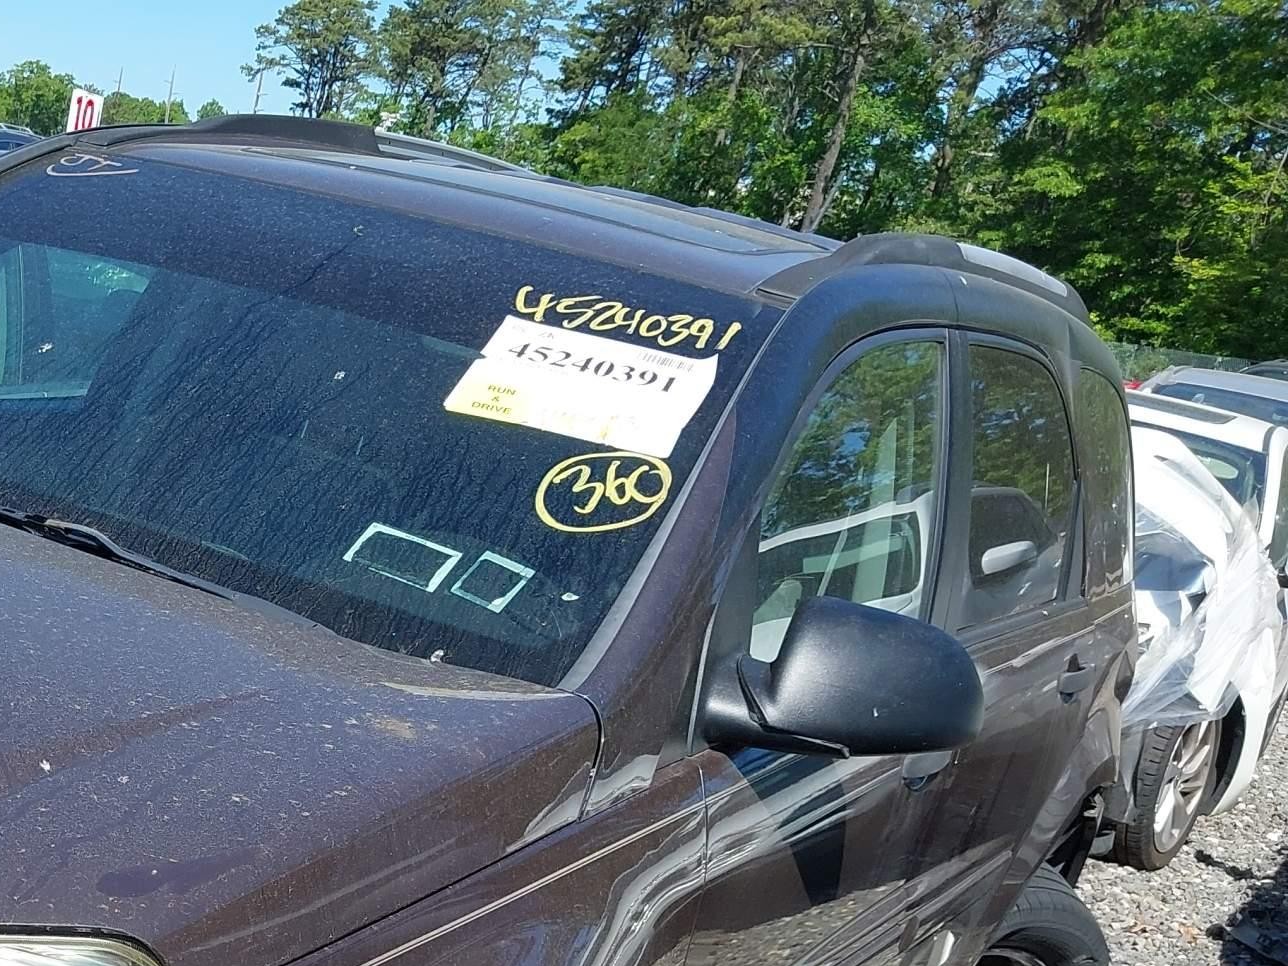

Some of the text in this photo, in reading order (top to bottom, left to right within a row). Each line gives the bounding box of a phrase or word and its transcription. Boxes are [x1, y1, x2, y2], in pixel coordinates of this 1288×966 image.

[73, 96, 94, 130] 10
[515, 285, 743, 350] 45240391
[508, 342, 677, 393] 45240391
[471, 401, 512, 415] DRIVE
[487, 384, 516, 396] RUN
[552, 460, 667, 514] 360
